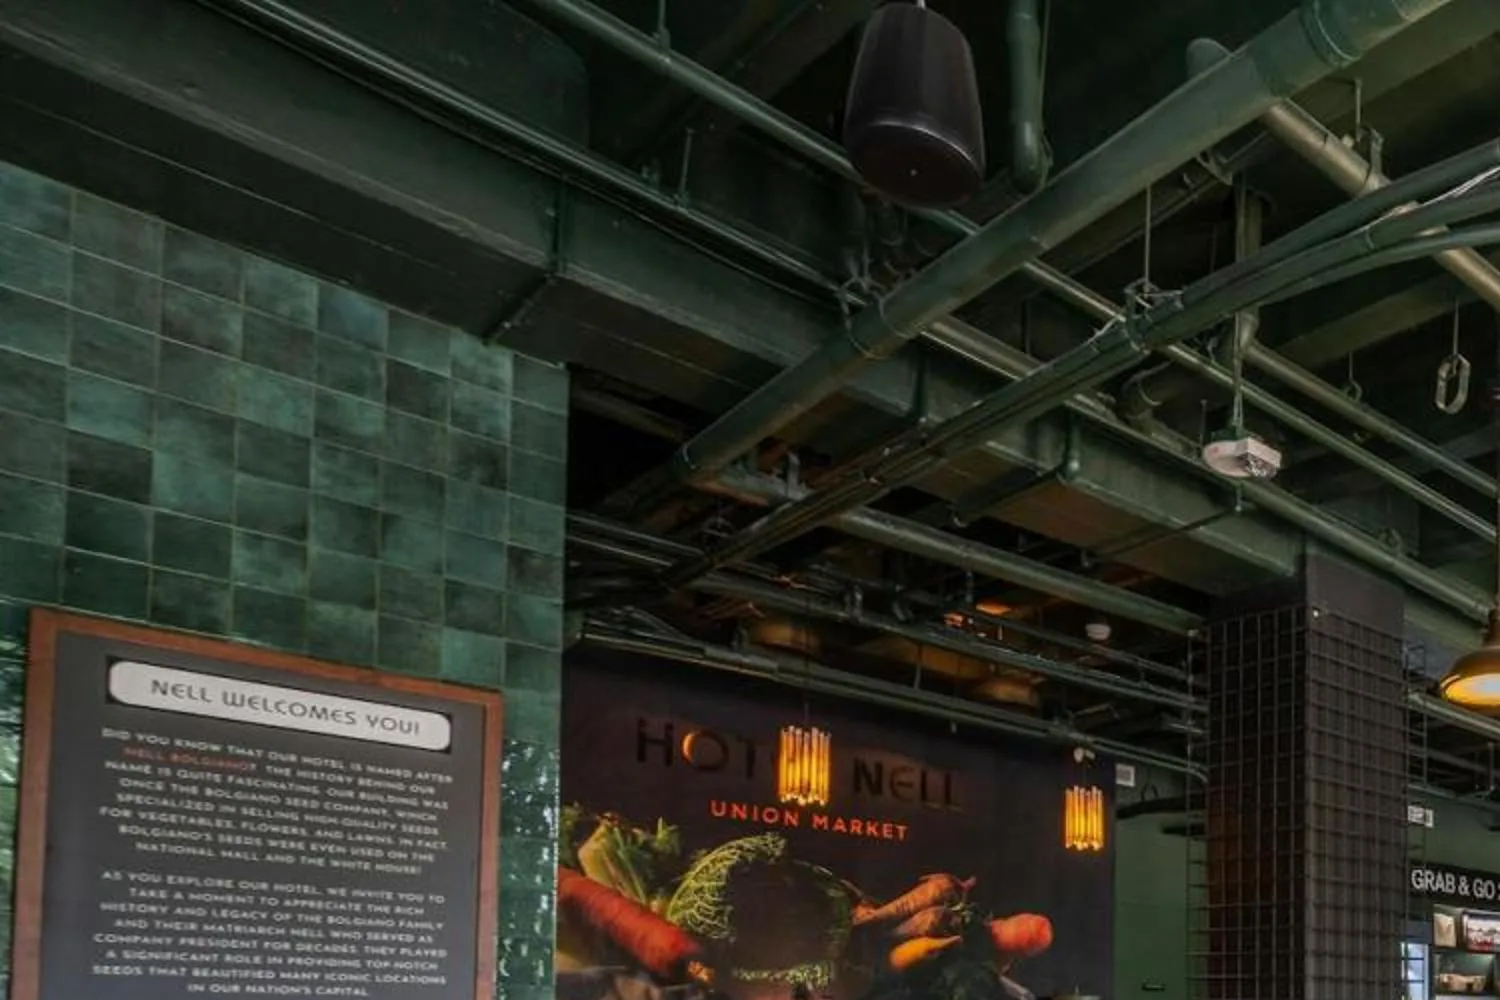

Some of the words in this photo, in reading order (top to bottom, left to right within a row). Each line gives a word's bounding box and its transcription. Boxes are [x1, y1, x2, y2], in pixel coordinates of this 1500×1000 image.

[150, 678, 212, 704] NELL
[220, 690, 357, 726] WELCOMES
[365, 713, 420, 736] YOU!
[852, 757, 963, 811] NELL
[710, 800, 799, 828] UNION
[812, 813, 909, 841] MARKET
[1410, 868, 1456, 894] GRAB
[1458, 874, 1470, 896] &
[1472, 878, 1495, 900] GO
